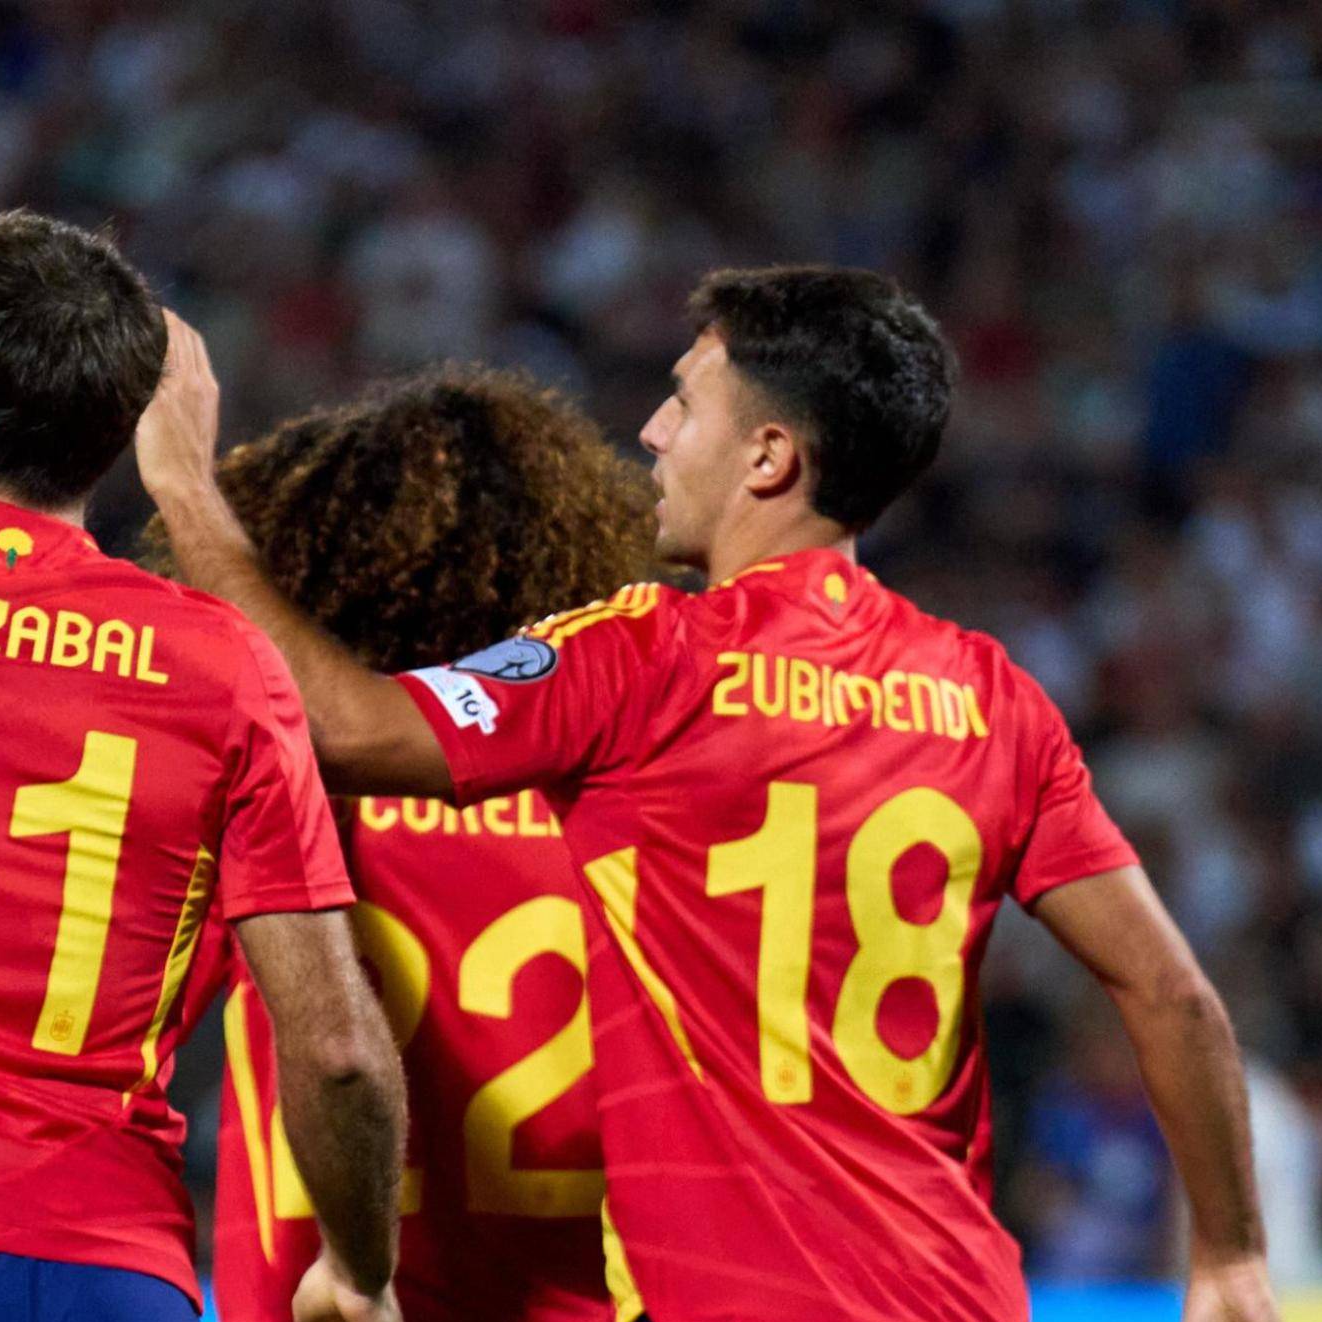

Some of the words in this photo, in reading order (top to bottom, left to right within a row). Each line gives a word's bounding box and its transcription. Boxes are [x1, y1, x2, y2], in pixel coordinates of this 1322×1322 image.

[712, 651, 988, 741] ZUBIMENDI
[360, 788, 562, 837] CUEL
[706, 781, 982, 1115] 18
